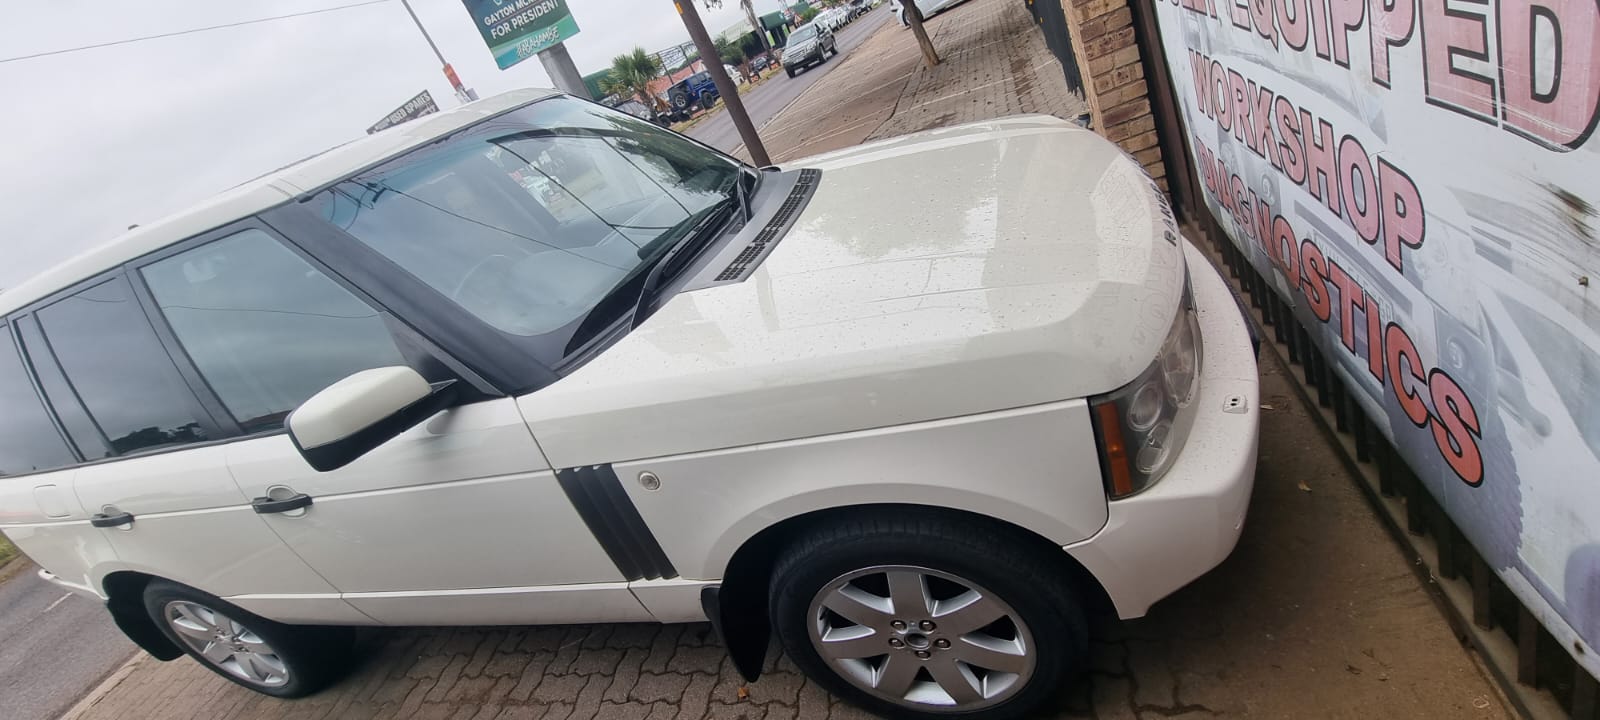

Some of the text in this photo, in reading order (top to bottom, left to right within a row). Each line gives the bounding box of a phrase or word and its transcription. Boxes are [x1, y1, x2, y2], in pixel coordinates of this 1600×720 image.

[484, 3, 516, 26] GAYTON
[490, 0, 559, 39] FOR PRESIDENT
[404, 92, 431, 114] SPARES
[1189, 47, 1425, 275] WORKSHOP
[1196, 135, 1485, 487] DIAGNOSTICS
